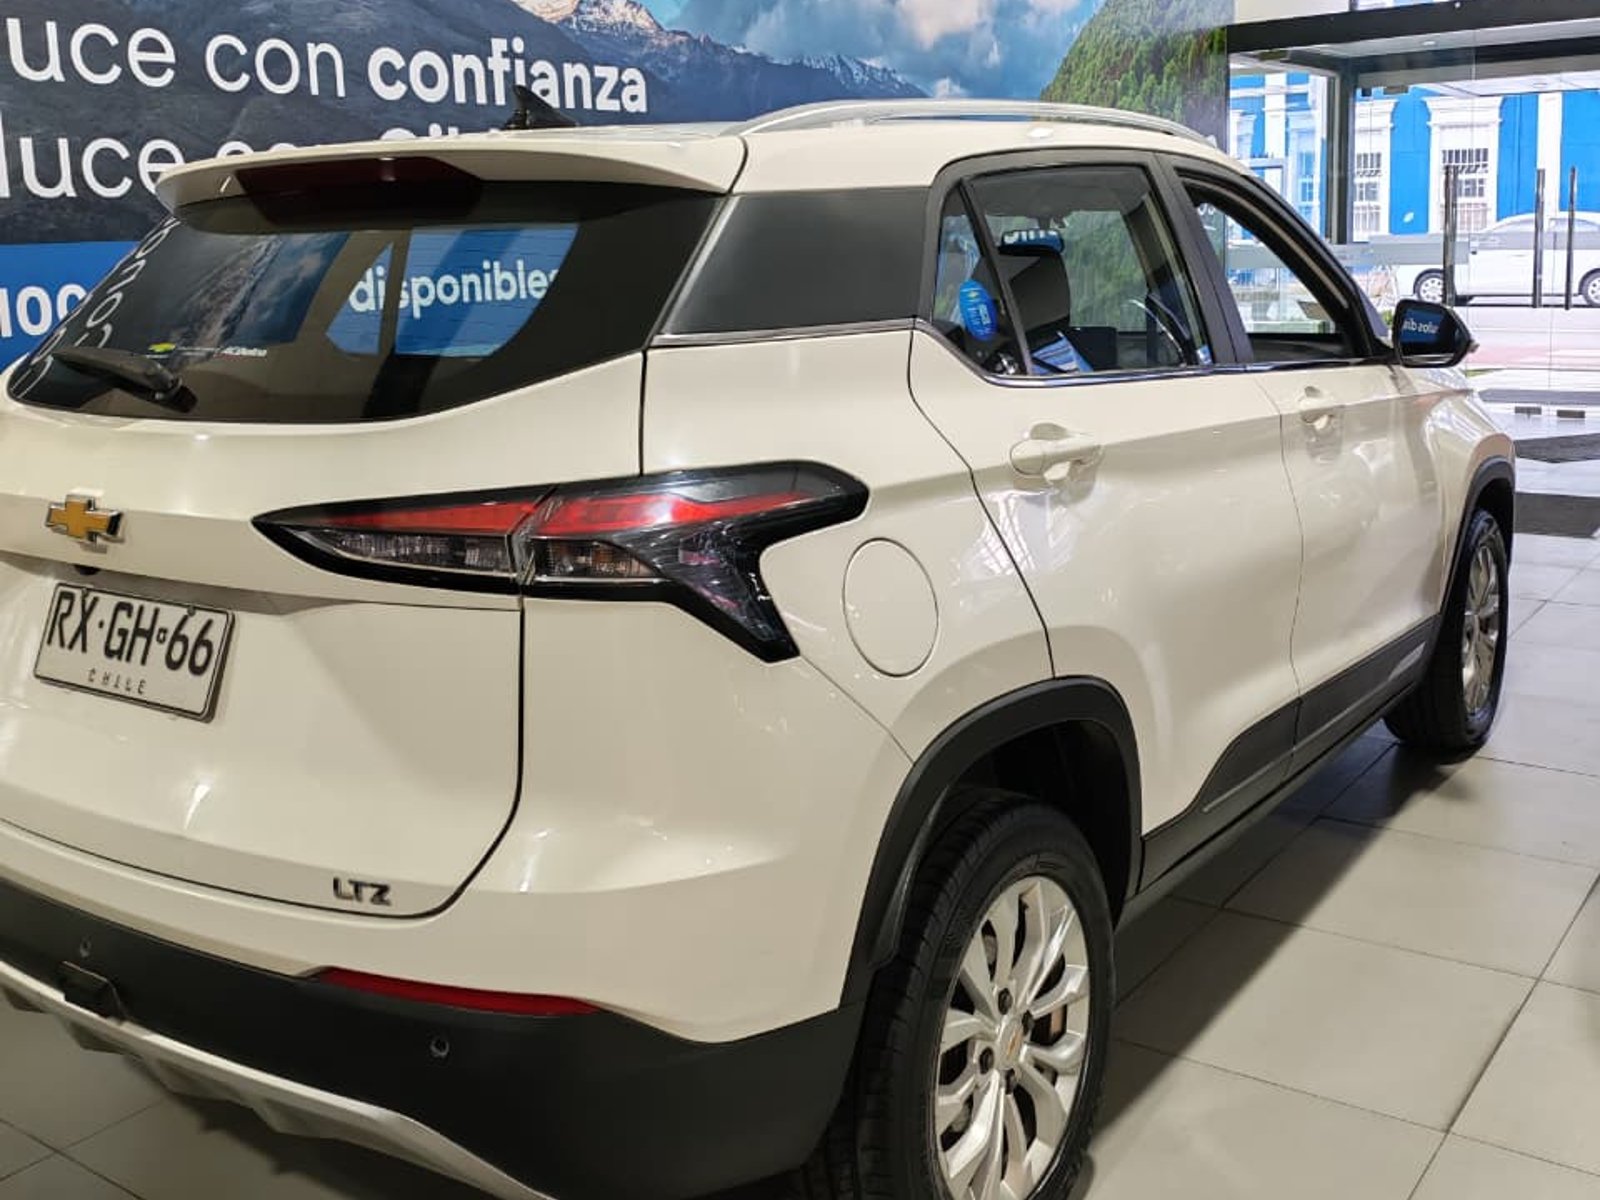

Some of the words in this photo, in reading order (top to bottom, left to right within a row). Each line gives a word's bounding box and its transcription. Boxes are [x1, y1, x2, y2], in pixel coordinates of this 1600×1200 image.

[204, 34, 346, 98] con
[367, 37, 648, 113] confianza
[87, 667, 148, 695] CHILE
[332, 876, 391, 907] LTZ
